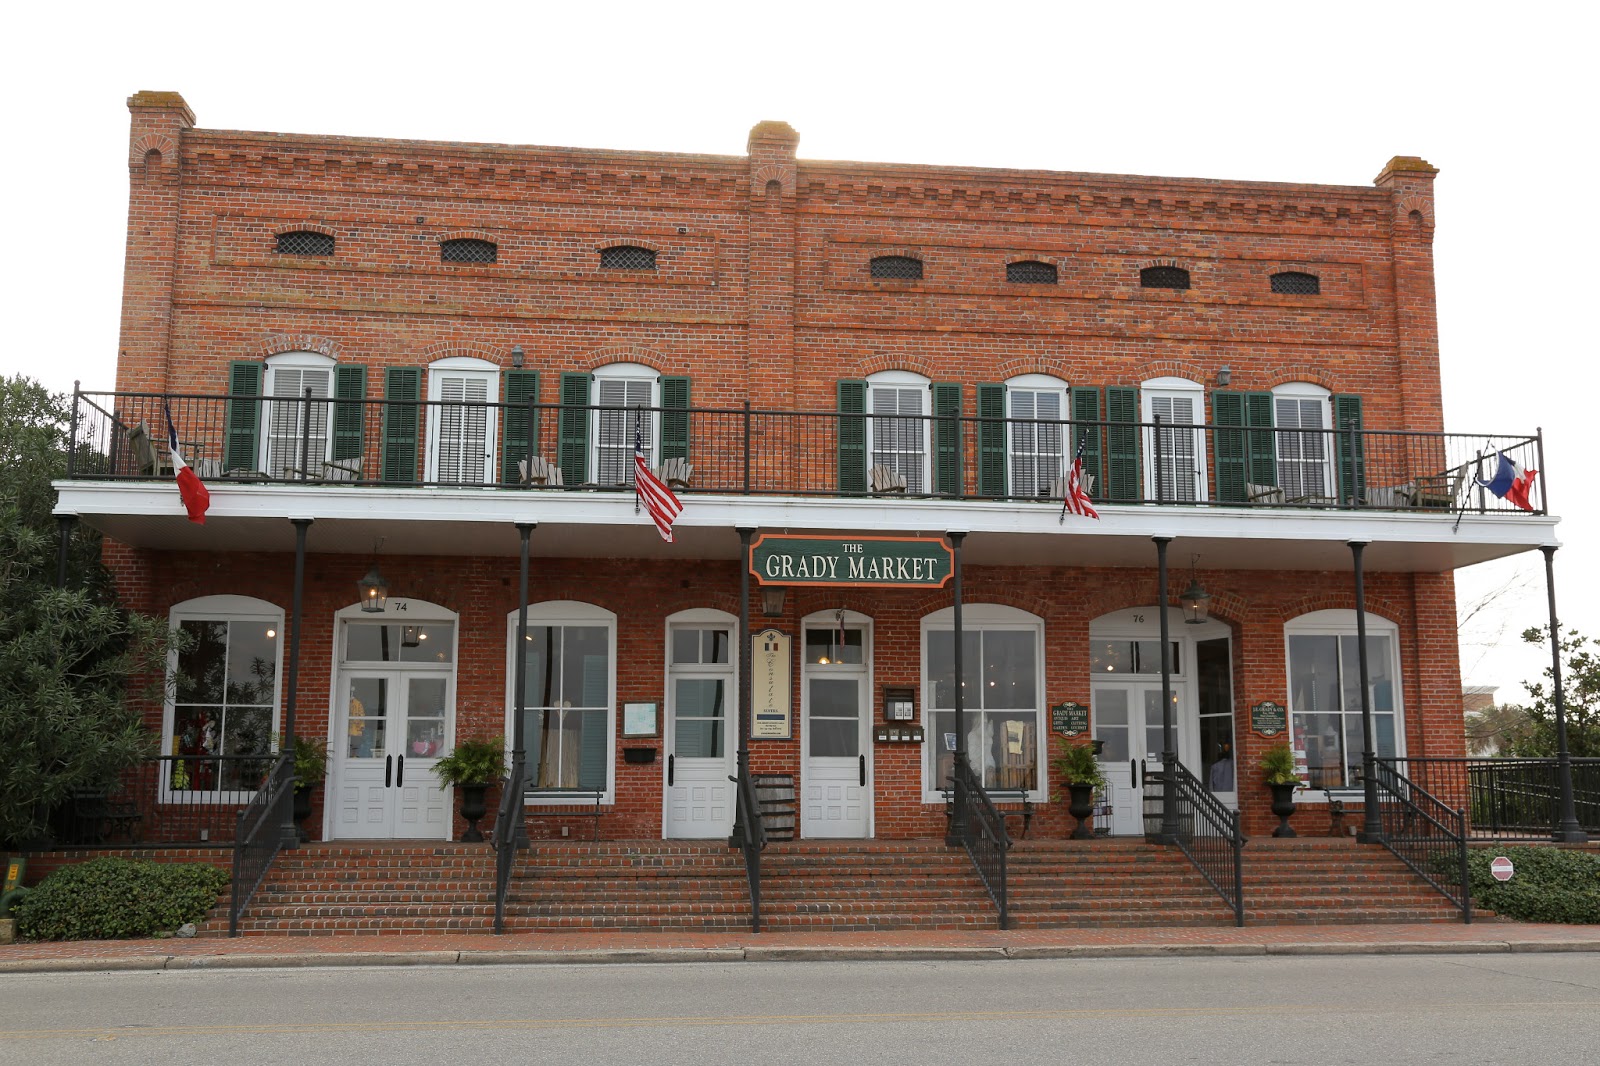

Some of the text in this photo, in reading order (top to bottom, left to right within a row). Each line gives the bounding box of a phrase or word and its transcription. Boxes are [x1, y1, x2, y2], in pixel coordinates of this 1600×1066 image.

[842, 543, 864, 553] THE
[765, 554, 938, 581] GRADY MARKET
[395, 602, 407, 611] 74
[1133, 614, 1145, 623] 76
